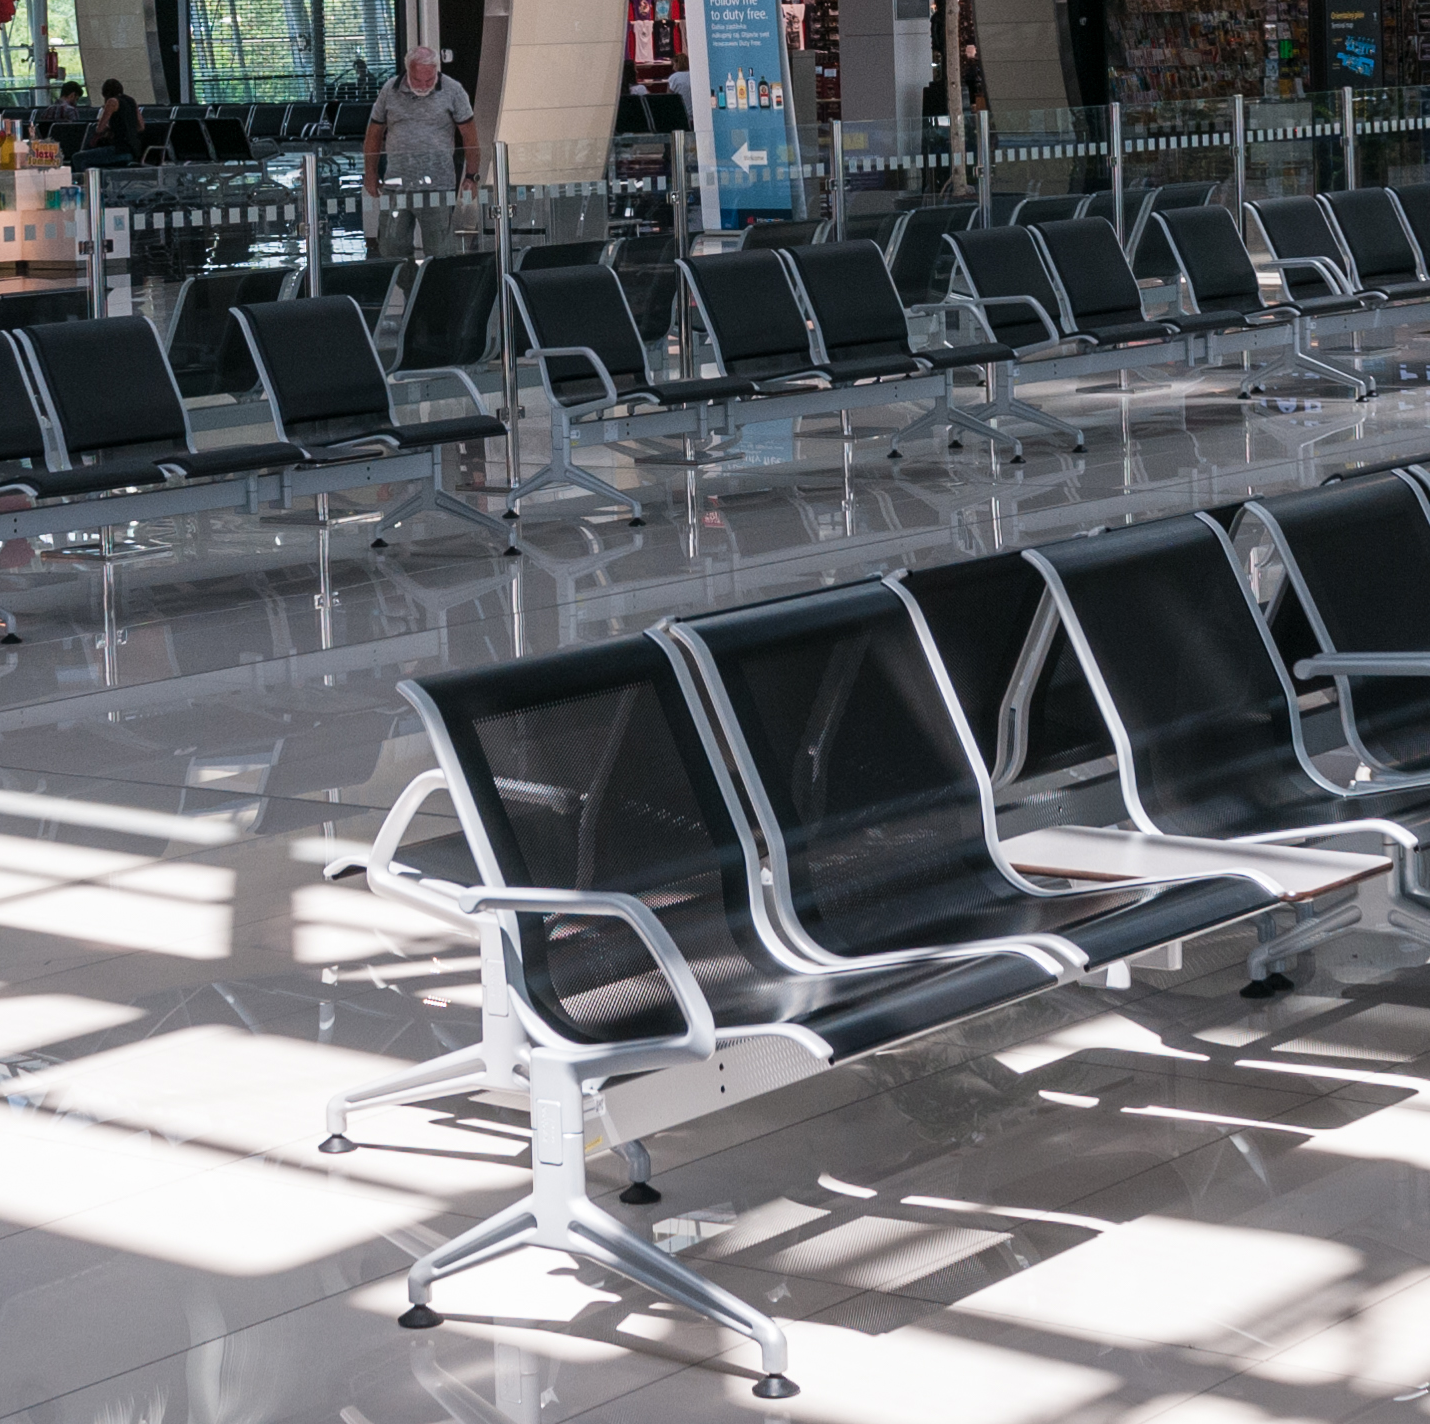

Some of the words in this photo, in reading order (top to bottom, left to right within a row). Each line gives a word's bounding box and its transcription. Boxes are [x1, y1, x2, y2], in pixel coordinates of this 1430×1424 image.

[711, 10, 720, 20] to
[723, 9, 744, 22] duty
[747, 8, 769, 20] free.
